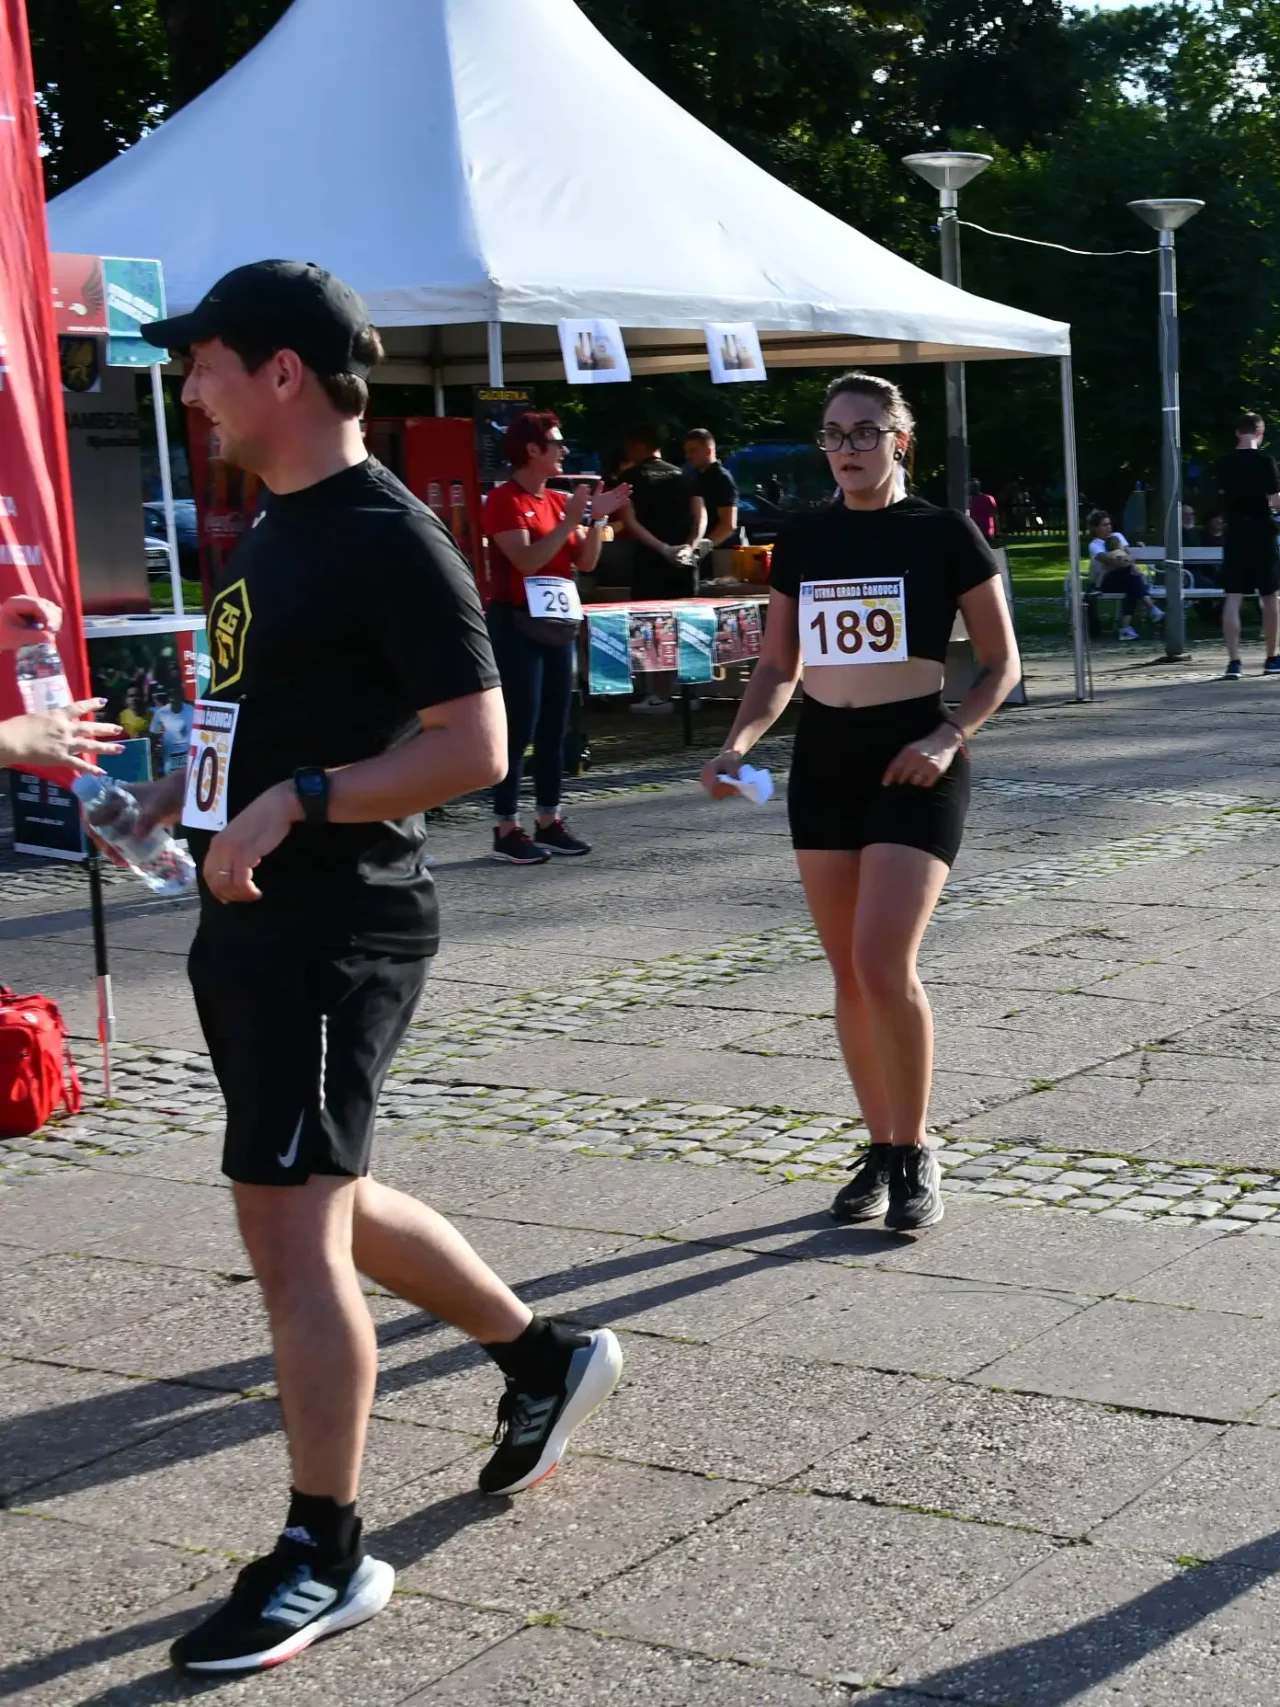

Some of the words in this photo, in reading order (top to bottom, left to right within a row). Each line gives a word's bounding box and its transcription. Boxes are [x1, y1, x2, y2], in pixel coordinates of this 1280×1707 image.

[543, 590, 570, 613] 29
[836, 585, 861, 598] GRADA
[810, 608, 895, 654] 189
